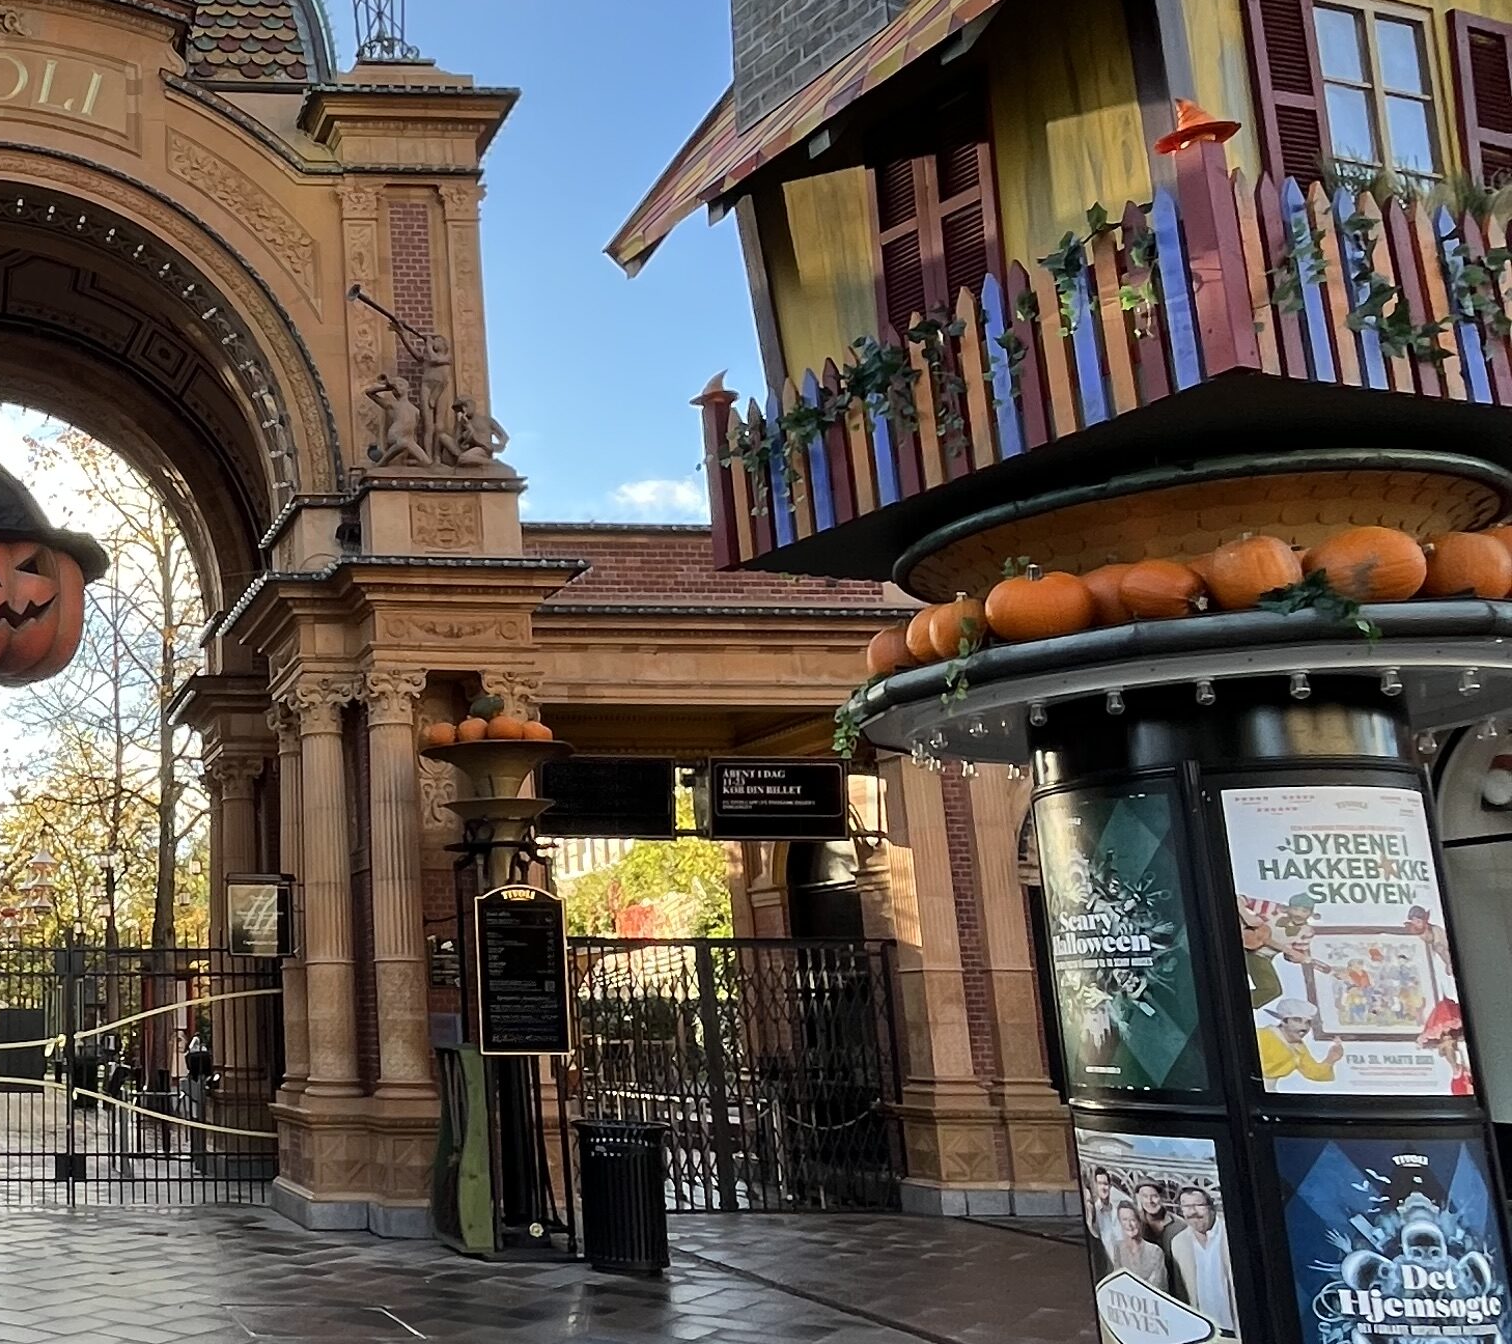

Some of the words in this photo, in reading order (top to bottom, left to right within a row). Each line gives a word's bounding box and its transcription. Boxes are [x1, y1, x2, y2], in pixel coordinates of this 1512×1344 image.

[764, 769, 786, 778] DAG
[746, 785, 764, 794] DIN
[766, 785, 802, 794] BILLET
[1292, 833, 1399, 855] DYRENE
[500, 889, 536, 900] TIVOLI
[1309, 883, 1413, 904] SKOVEN
[1058, 911, 1112, 935] Scary
[1392, 1154, 1429, 1166] TIVOLI
[1400, 1264, 1457, 1290] Det
[1108, 1288, 1161, 1317] TIVOLI
